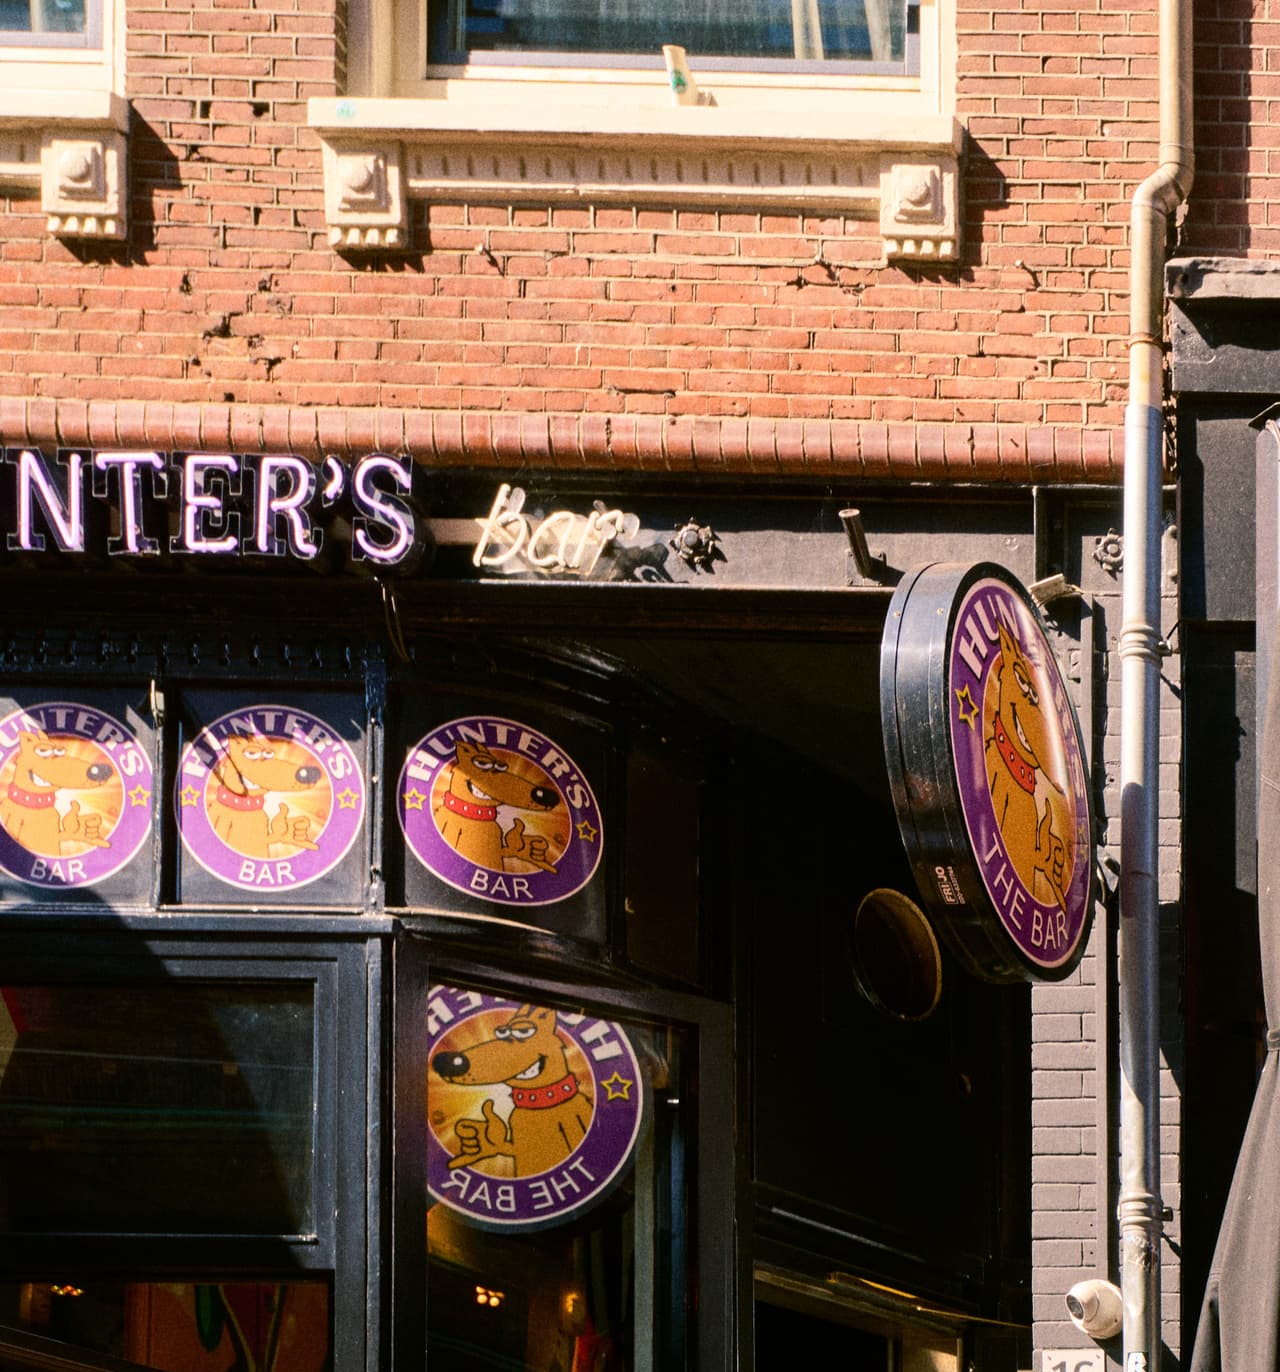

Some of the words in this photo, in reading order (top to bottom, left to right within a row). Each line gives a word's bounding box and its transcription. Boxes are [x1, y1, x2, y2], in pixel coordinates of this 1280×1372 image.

[2, 446, 414, 565] NTER'S
[0, 708, 145, 778] UNTER'S
[184, 711, 352, 780] HUNTER'S
[406, 721, 591, 810] HUNTER'S
[30, 858, 87, 882] BAR
[238, 860, 297, 886] BAR
[469, 868, 534, 900] BAR
[983, 835, 1025, 930] THE
[1031, 908, 1070, 950] BAR
